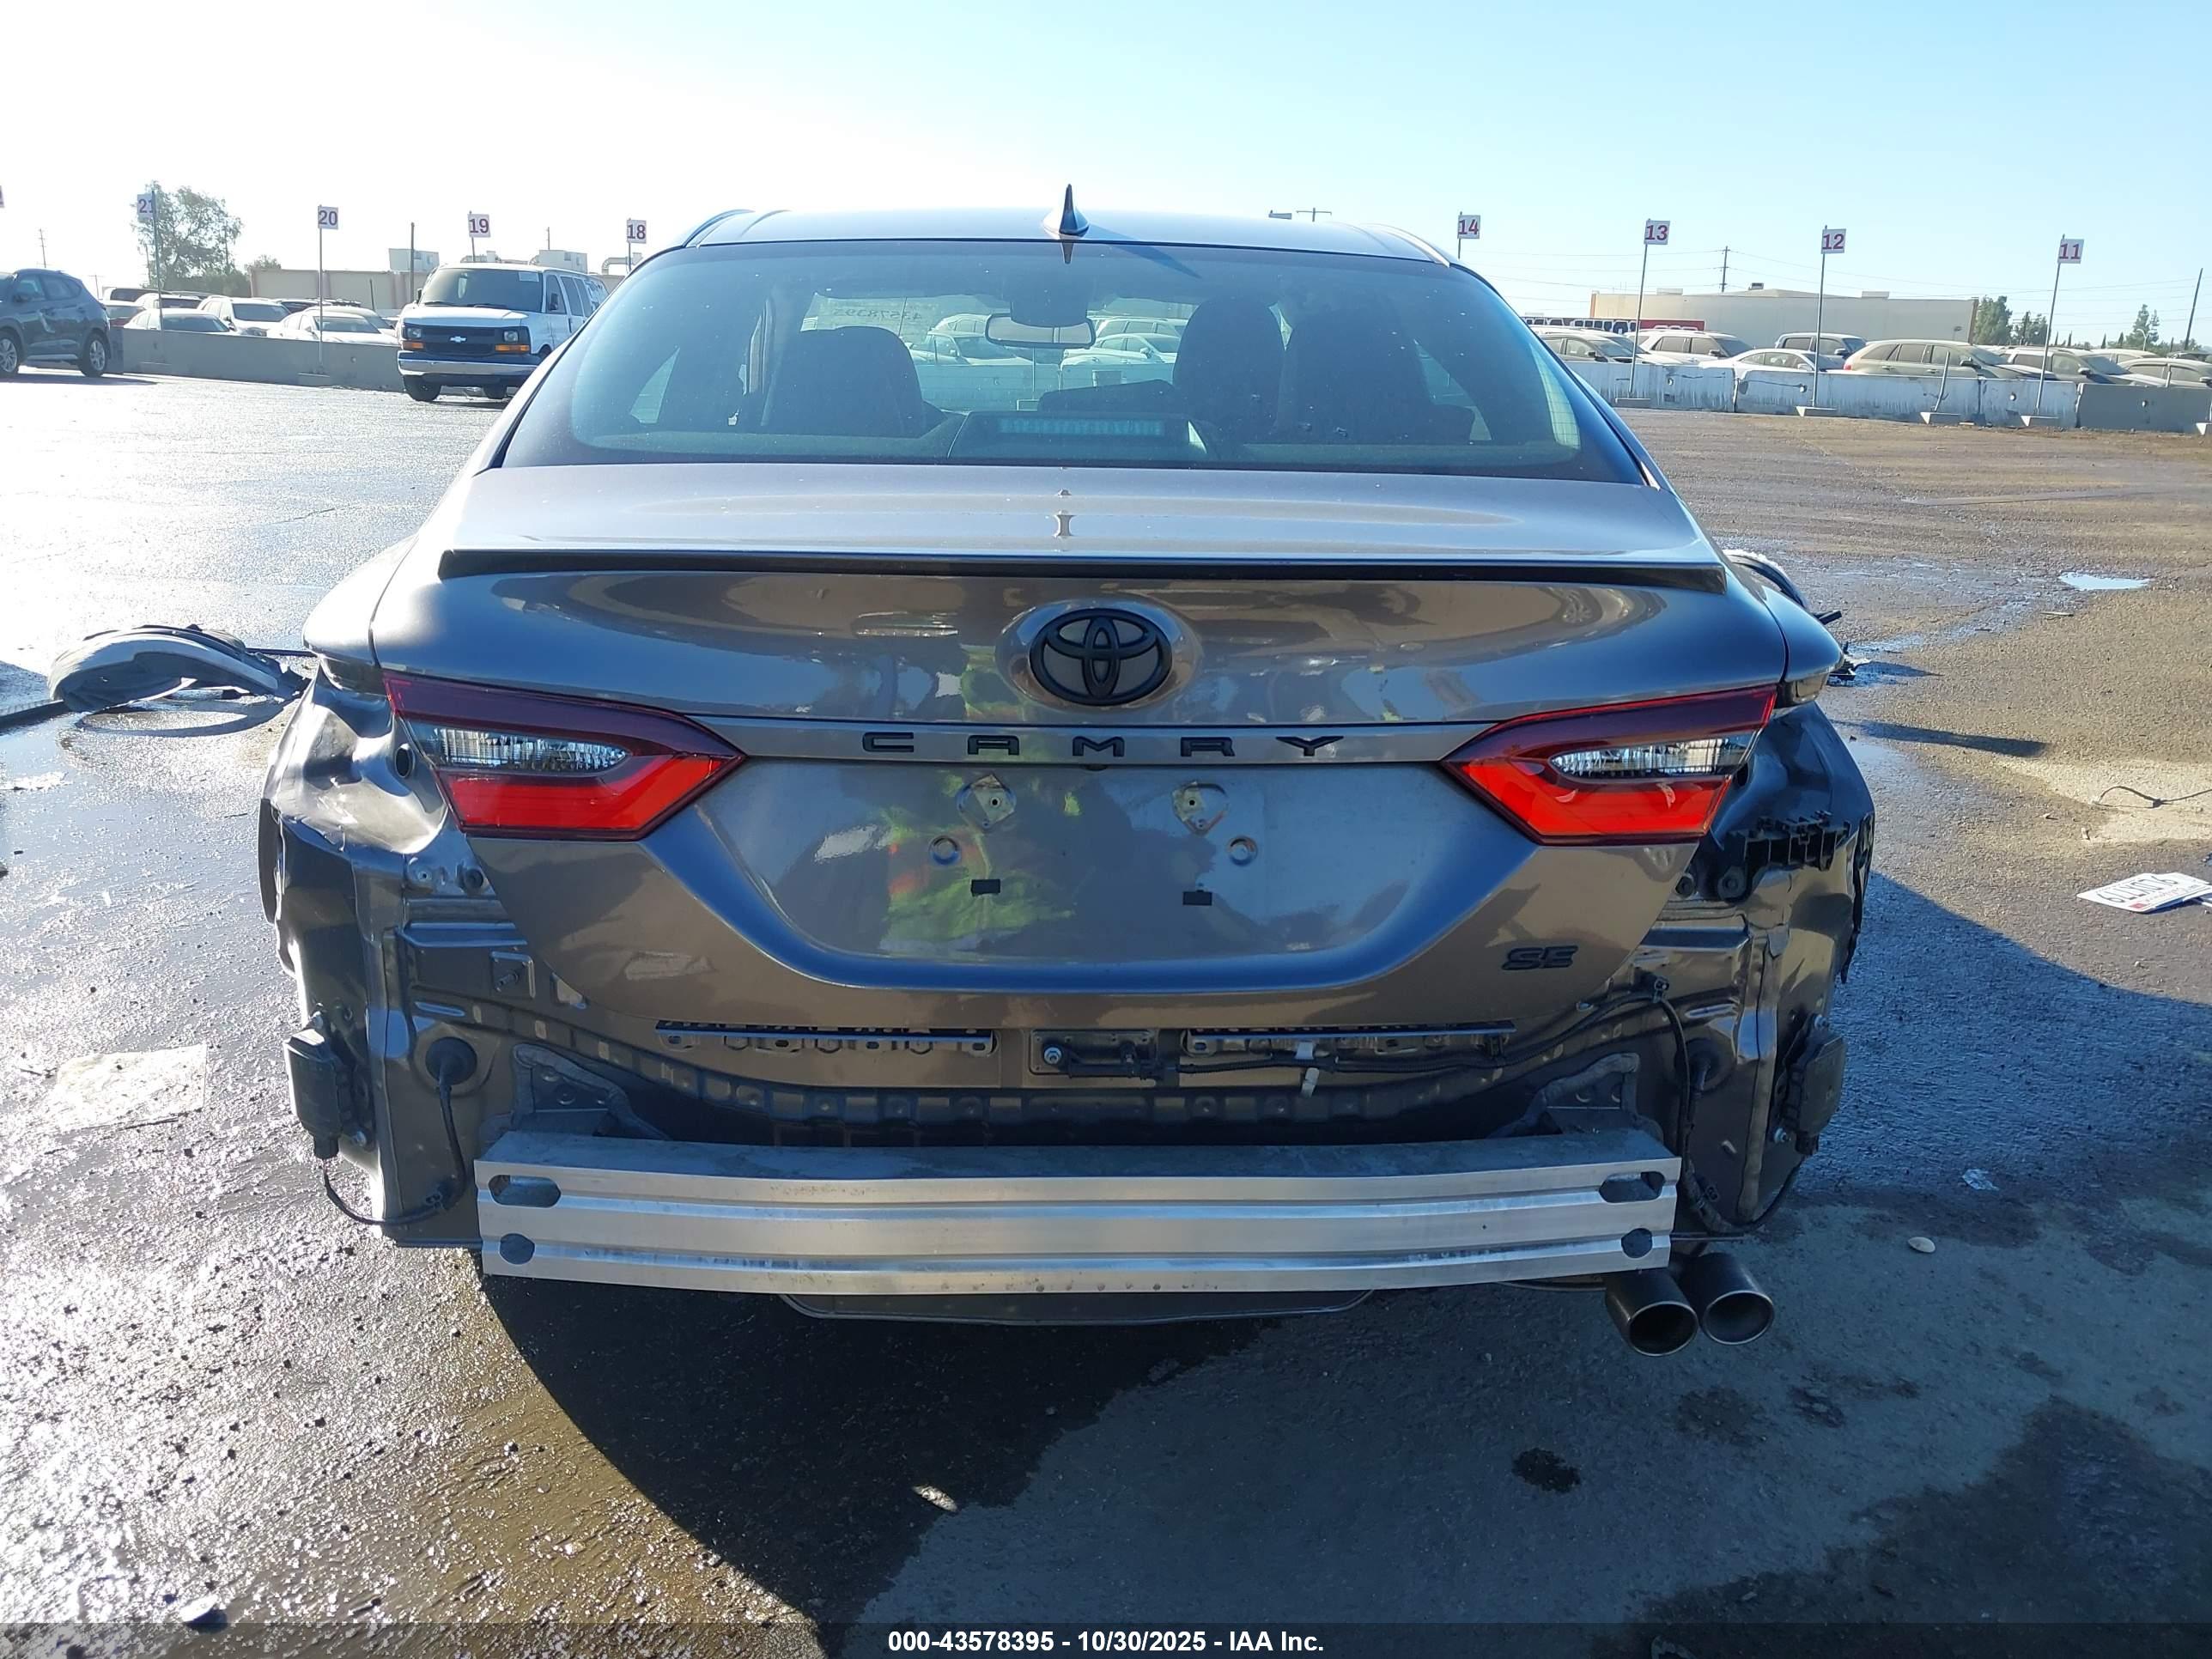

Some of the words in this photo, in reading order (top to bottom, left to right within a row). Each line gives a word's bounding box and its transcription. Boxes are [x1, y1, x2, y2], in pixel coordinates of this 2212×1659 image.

[319, 210, 338, 226] 20
[470, 218, 489, 234] 19
[627, 224, 646, 240] 18
[1458, 219, 1479, 235] 14
[1645, 224, 1668, 241] 13
[1822, 234, 1844, 250] 12
[2059, 243, 2081, 260] 11
[861, 731, 1345, 757] CAMRY
[1500, 945, 1579, 970] SE
